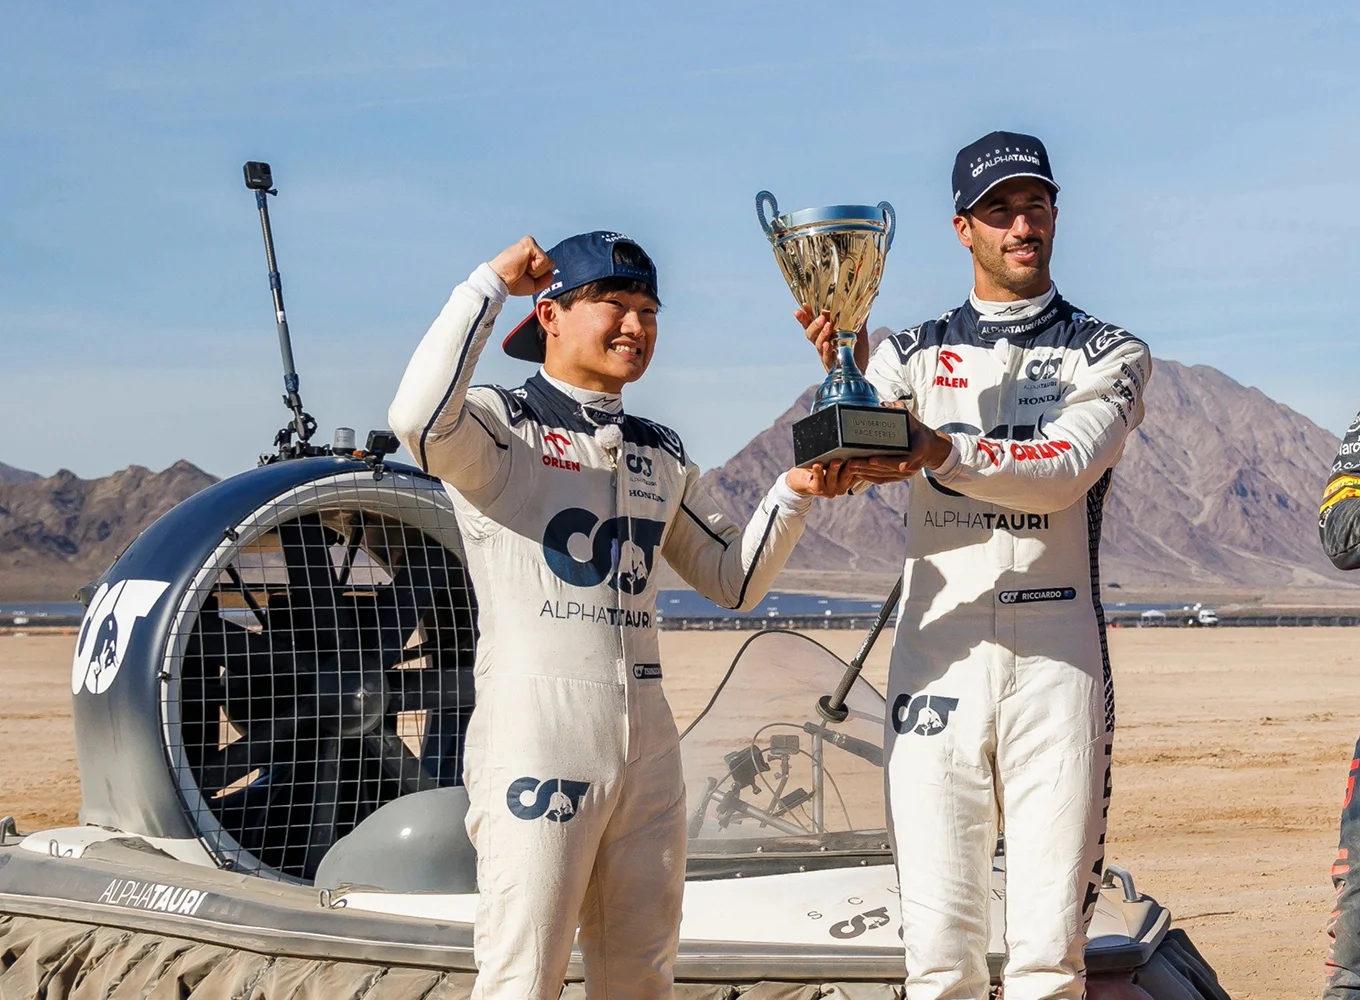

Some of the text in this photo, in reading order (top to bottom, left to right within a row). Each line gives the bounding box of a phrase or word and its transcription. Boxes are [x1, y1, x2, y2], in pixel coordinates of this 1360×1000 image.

[984, 154, 1041, 169] ALPHATAURI
[542, 455, 581, 472] ORLEN
[923, 511, 1049, 530] ALPHATAURI
[1022, 590, 1062, 601] RICCIARDO
[98, 878, 208, 915] ALPHATAURI
